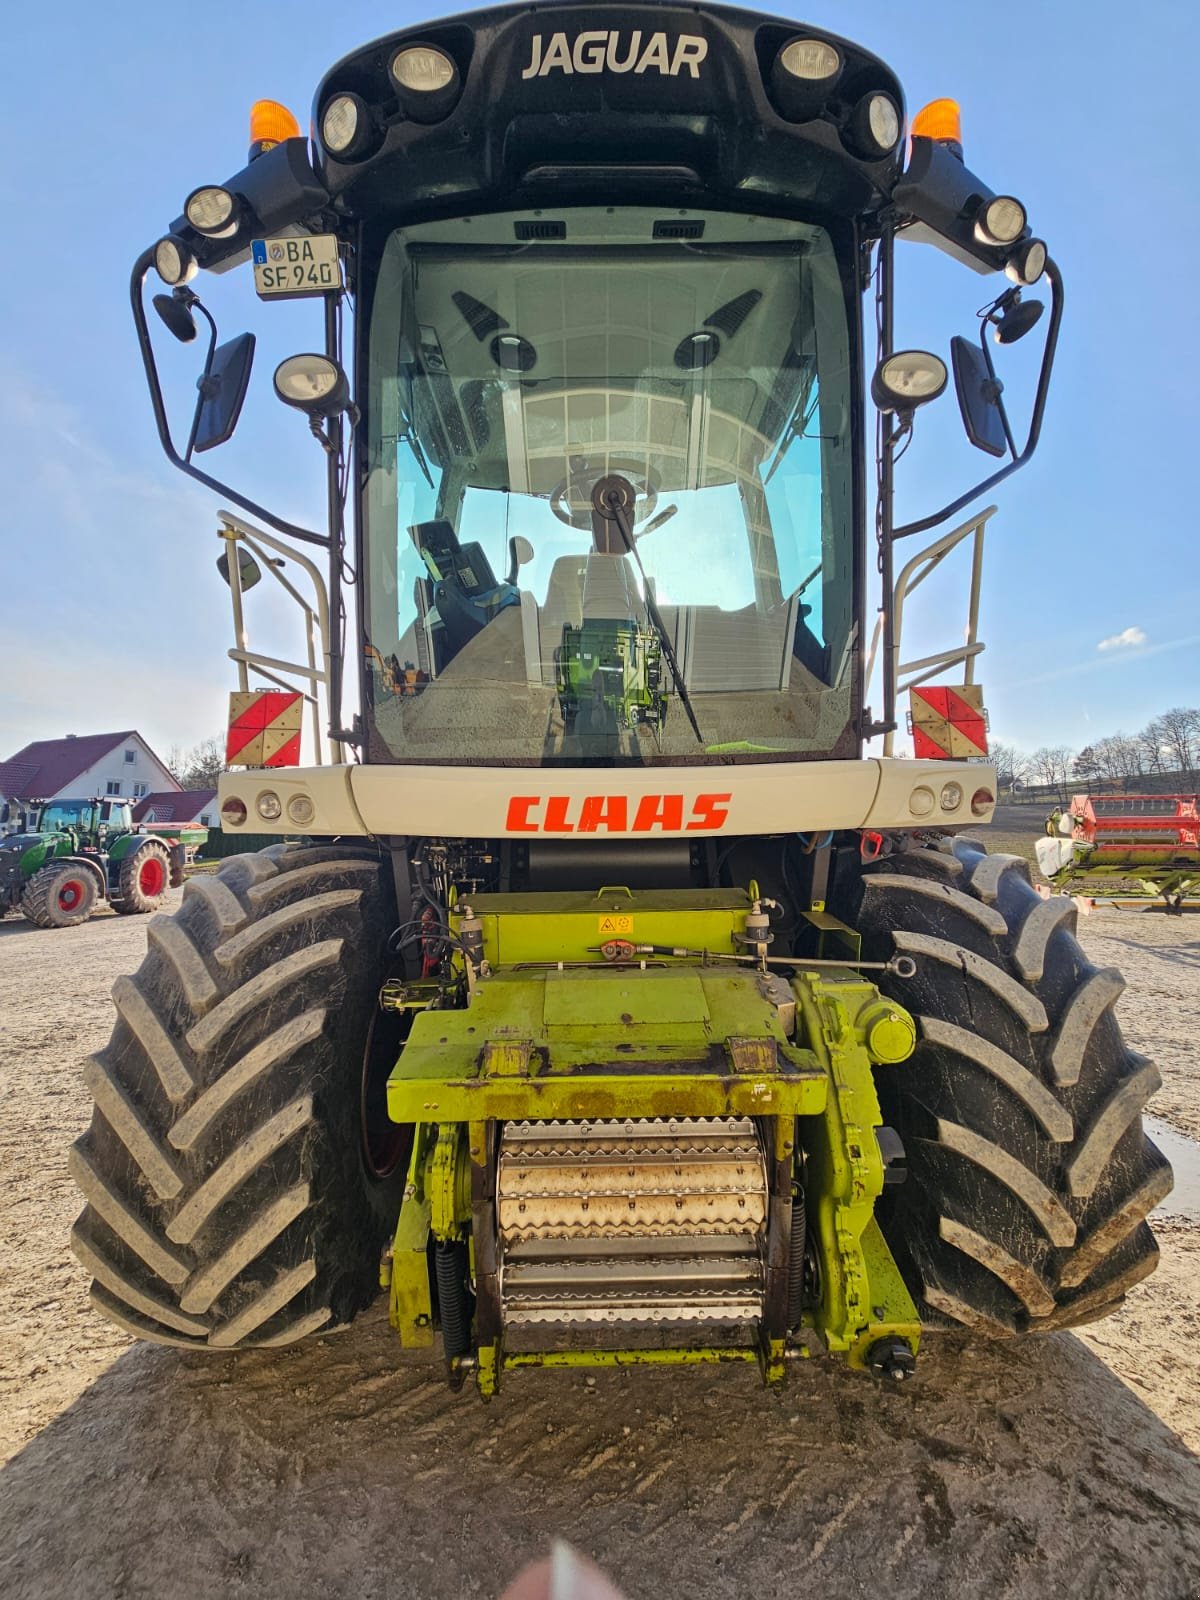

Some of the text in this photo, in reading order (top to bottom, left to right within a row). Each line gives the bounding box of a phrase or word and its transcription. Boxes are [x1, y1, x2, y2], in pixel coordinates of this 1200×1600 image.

[522, 30, 709, 80] JAGUAR
[286, 240, 314, 262] BA
[262, 263, 332, 287] SF 940
[505, 793, 733, 832] CLAAS
